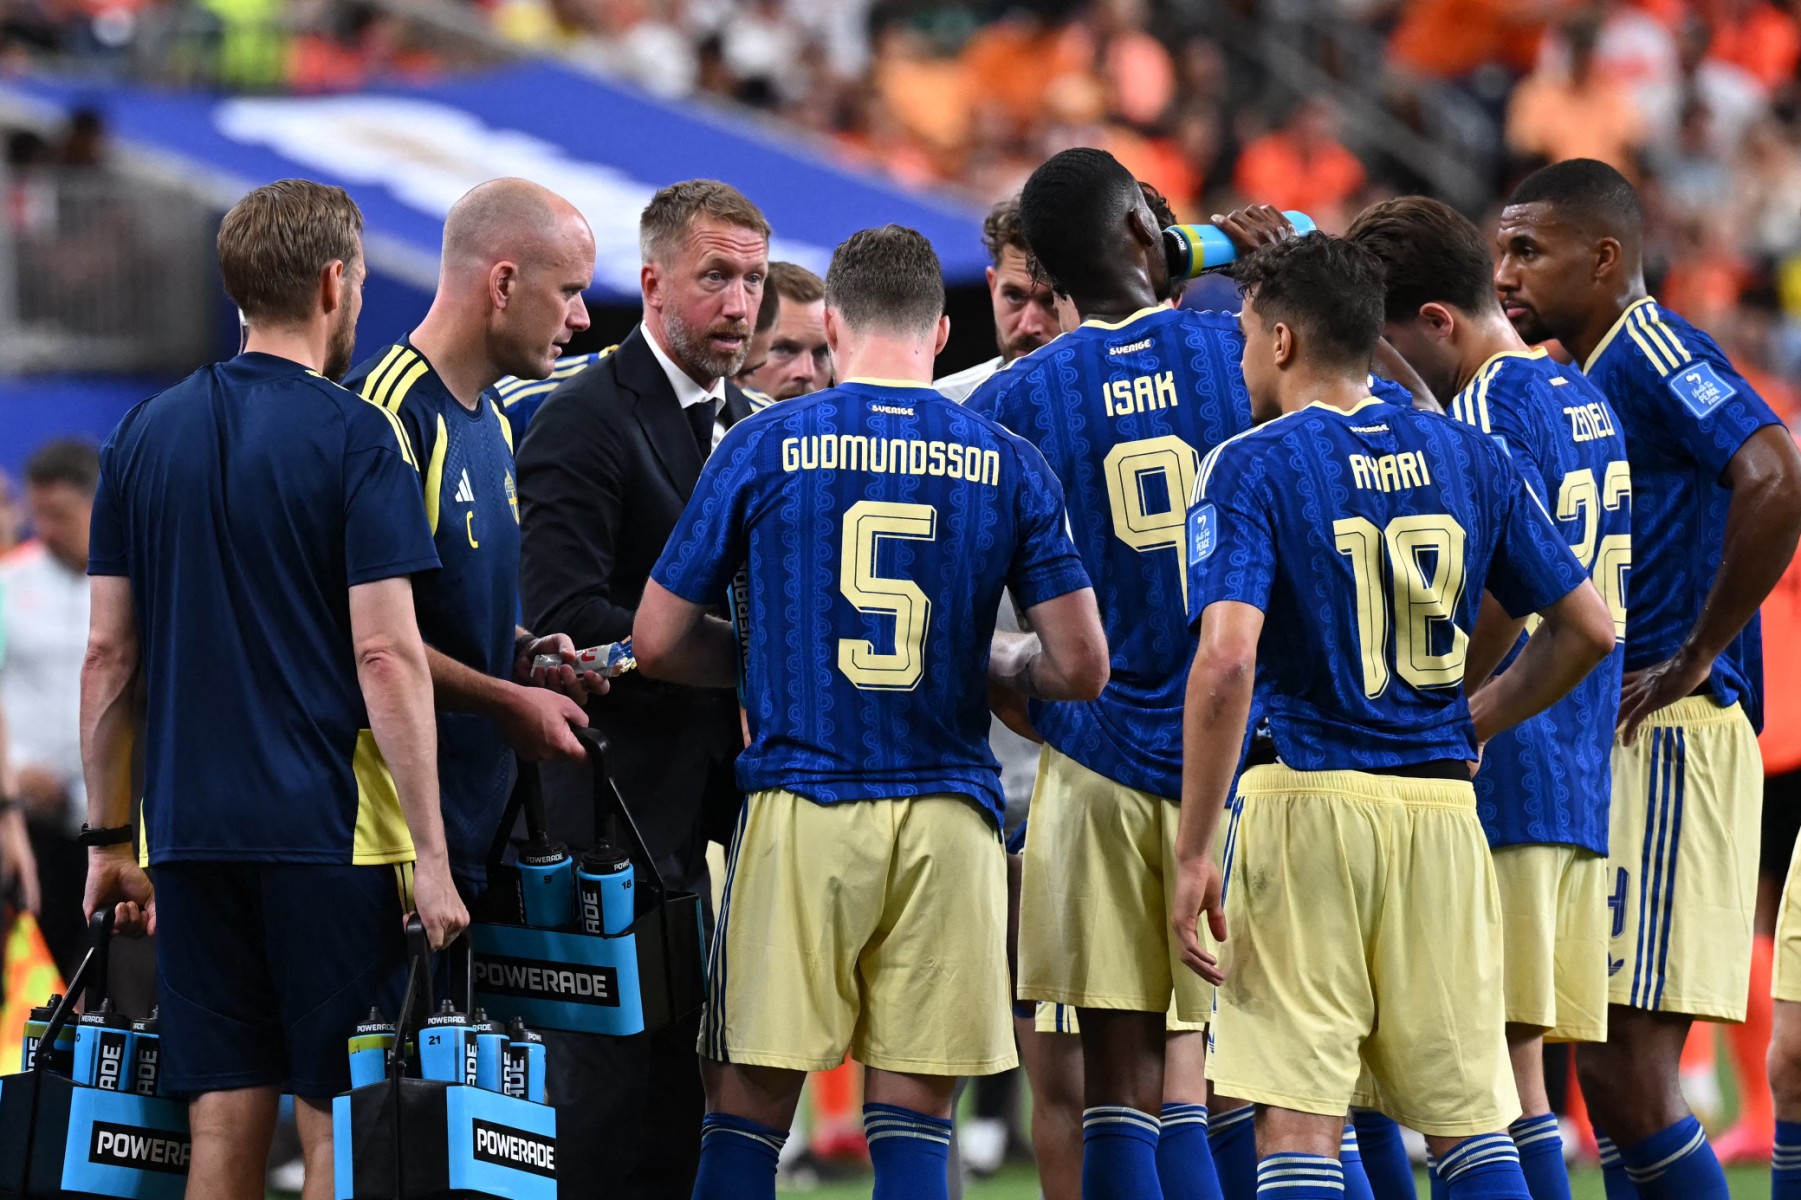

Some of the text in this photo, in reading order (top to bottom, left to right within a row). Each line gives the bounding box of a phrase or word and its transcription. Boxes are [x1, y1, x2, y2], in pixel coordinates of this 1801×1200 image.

[872, 405, 914, 416] SVERIGE
[1103, 371, 1178, 417] ISAK
[782, 434, 1000, 486] GUDMUNDSSON
[1349, 450, 1431, 493] AYARI
[1103, 434, 1201, 616] 9
[838, 500, 937, 692] 5
[1333, 514, 1470, 700] 18
[526, 853, 564, 863] POWERADE
[622, 880, 632, 890] 18
[473, 961, 608, 998] POWERADE
[356, 1023, 396, 1032] POWERADE
[428, 1016, 466, 1025] POWERADE
[428, 1035, 441, 1045] 21
[97, 1130, 192, 1166] POWERA
[476, 1128, 555, 1170] POWERADE
